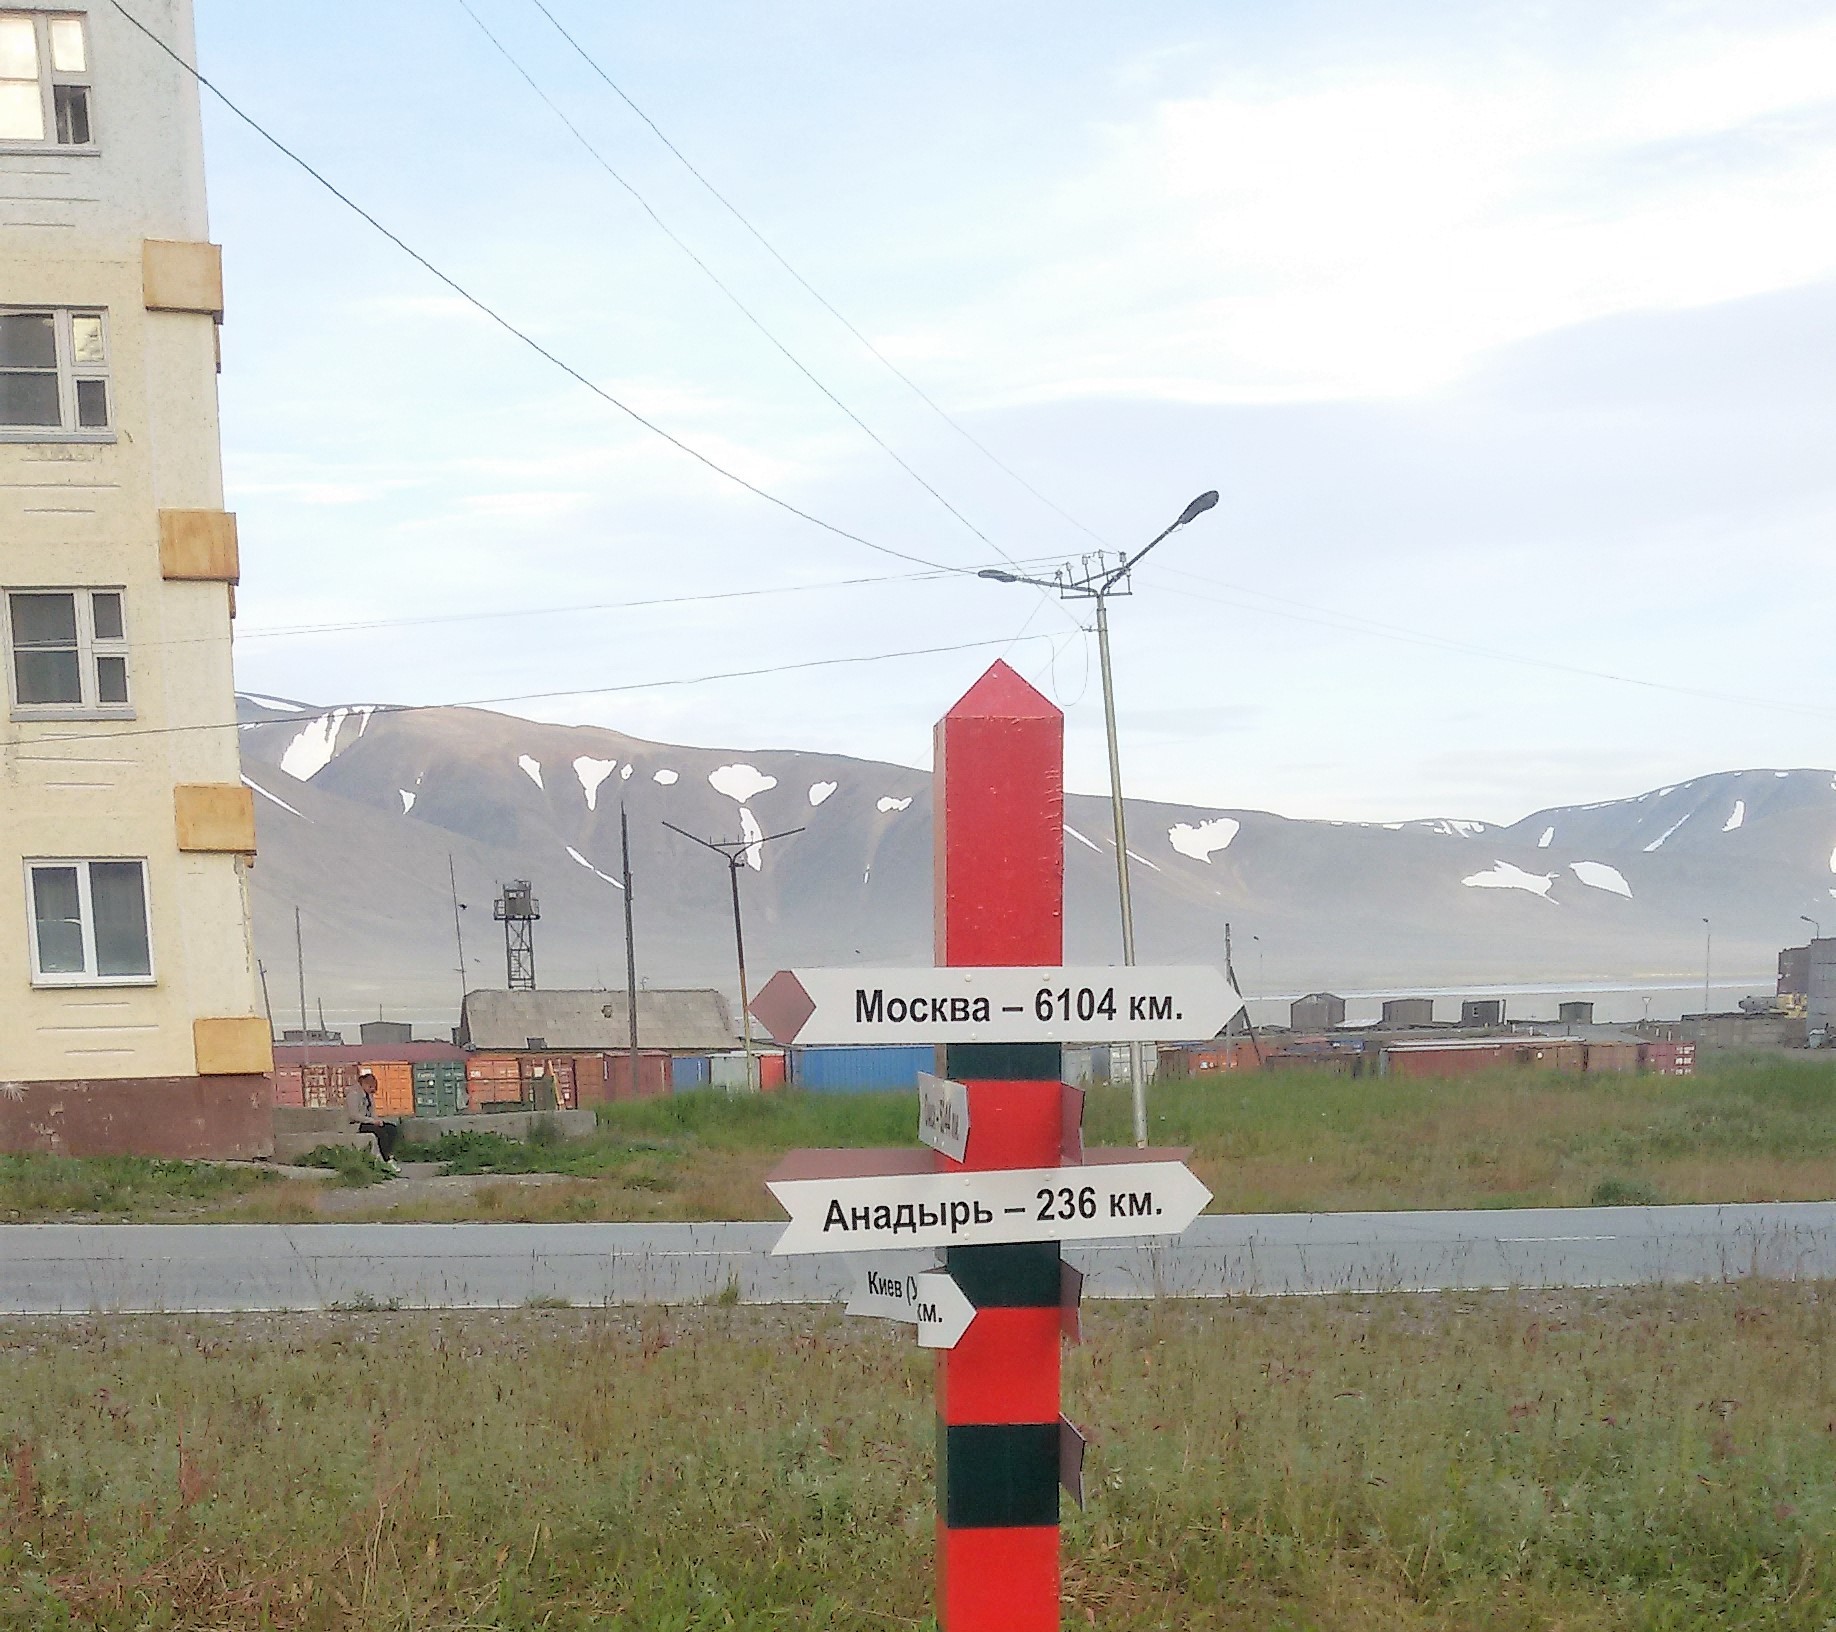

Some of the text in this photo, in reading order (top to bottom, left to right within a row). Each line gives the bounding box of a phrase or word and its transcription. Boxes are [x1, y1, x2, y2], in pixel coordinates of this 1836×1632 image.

[856, 989, 991, 1023] Москва
[1035, 987, 1117, 1022] 6104
[1130, 995, 1183, 1021] км.
[823, 1199, 993, 1234] Анадырь
[1036, 1186, 1097, 1221] 236
[1109, 1192, 1162, 1217] км.
[867, 1271, 903, 1298] Киев
